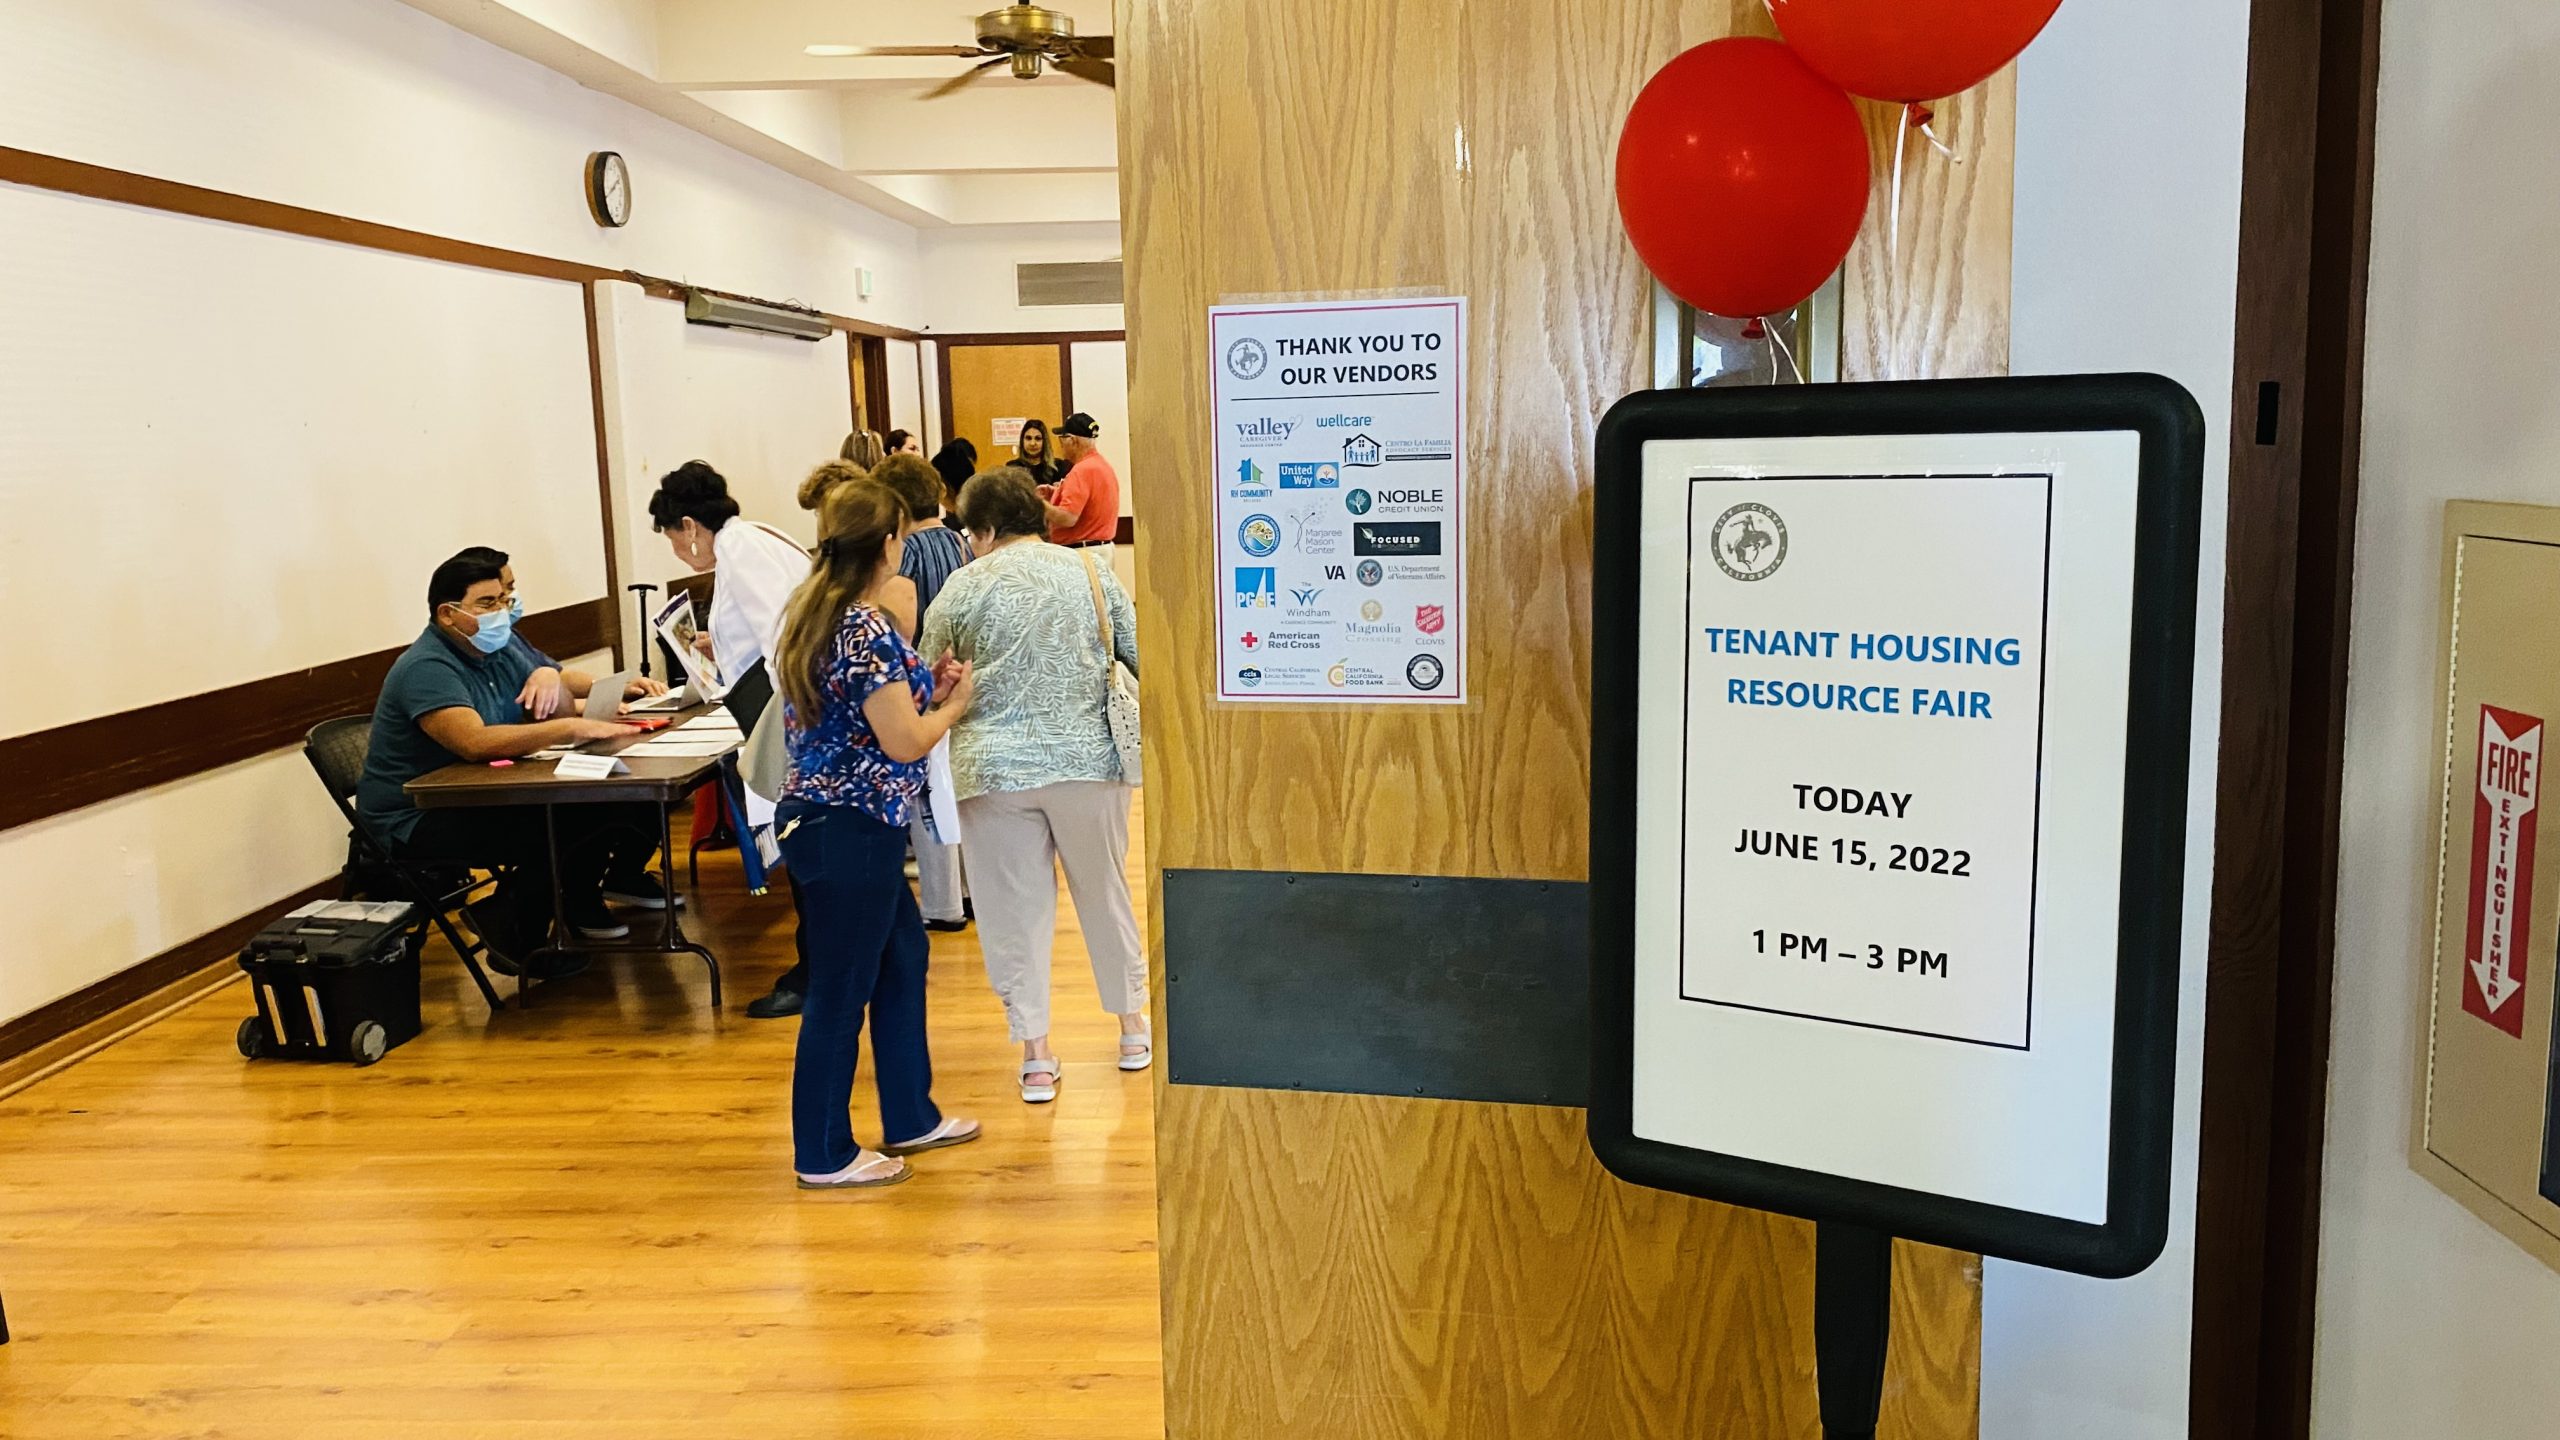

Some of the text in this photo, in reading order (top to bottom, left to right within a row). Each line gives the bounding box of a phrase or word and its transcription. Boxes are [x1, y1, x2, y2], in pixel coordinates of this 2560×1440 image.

[1276, 333, 1441, 356] THANK YOU TO
[1281, 363, 1437, 385] OUR VENDORS
[1316, 414, 1372, 427] wellcare
[1236, 418, 1295, 440] valley
[1281, 465, 1312, 475] United
[1293, 476, 1312, 487] Way
[1240, 489, 1273, 497] COMMUNITY
[1378, 490, 1443, 503] NOBLE
[1715, 510, 1733, 533] CITY
[1751, 504, 1784, 533] CLOVIS
[1305, 529, 1342, 537] Marjaree
[1305, 538, 1334, 546] Mason
[1370, 536, 1420, 544] FOCUSED
[1305, 546, 1335, 554] Center
[1324, 566, 1346, 580] VA
[1401, 565, 1440, 573] Department
[1717, 559, 1781, 580] CALIFORNIA
[1236, 592, 1275, 608] PG&E
[1286, 608, 1330, 617] Windham
[1345, 622, 1401, 634] Magnolia
[1268, 632, 1320, 640] American
[1345, 634, 1401, 644] Crossing
[1268, 641, 1320, 649] Red Cross
[1705, 628, 2021, 666] TENANT HOUSING
[1728, 679, 1992, 719] RESOURCE FAIR
[2487, 742, 2532, 798] FIRE
[1793, 784, 1912, 818] TODAY
[1735, 829, 1971, 877] JUNE 15, 2022
[2487, 798, 2512, 999] EXTINGUISHER
[1752, 929, 1765, 954] 1
[1780, 933, 1828, 962] PM
[1866, 944, 1884, 970] 3
[1897, 947, 1948, 978] PM
